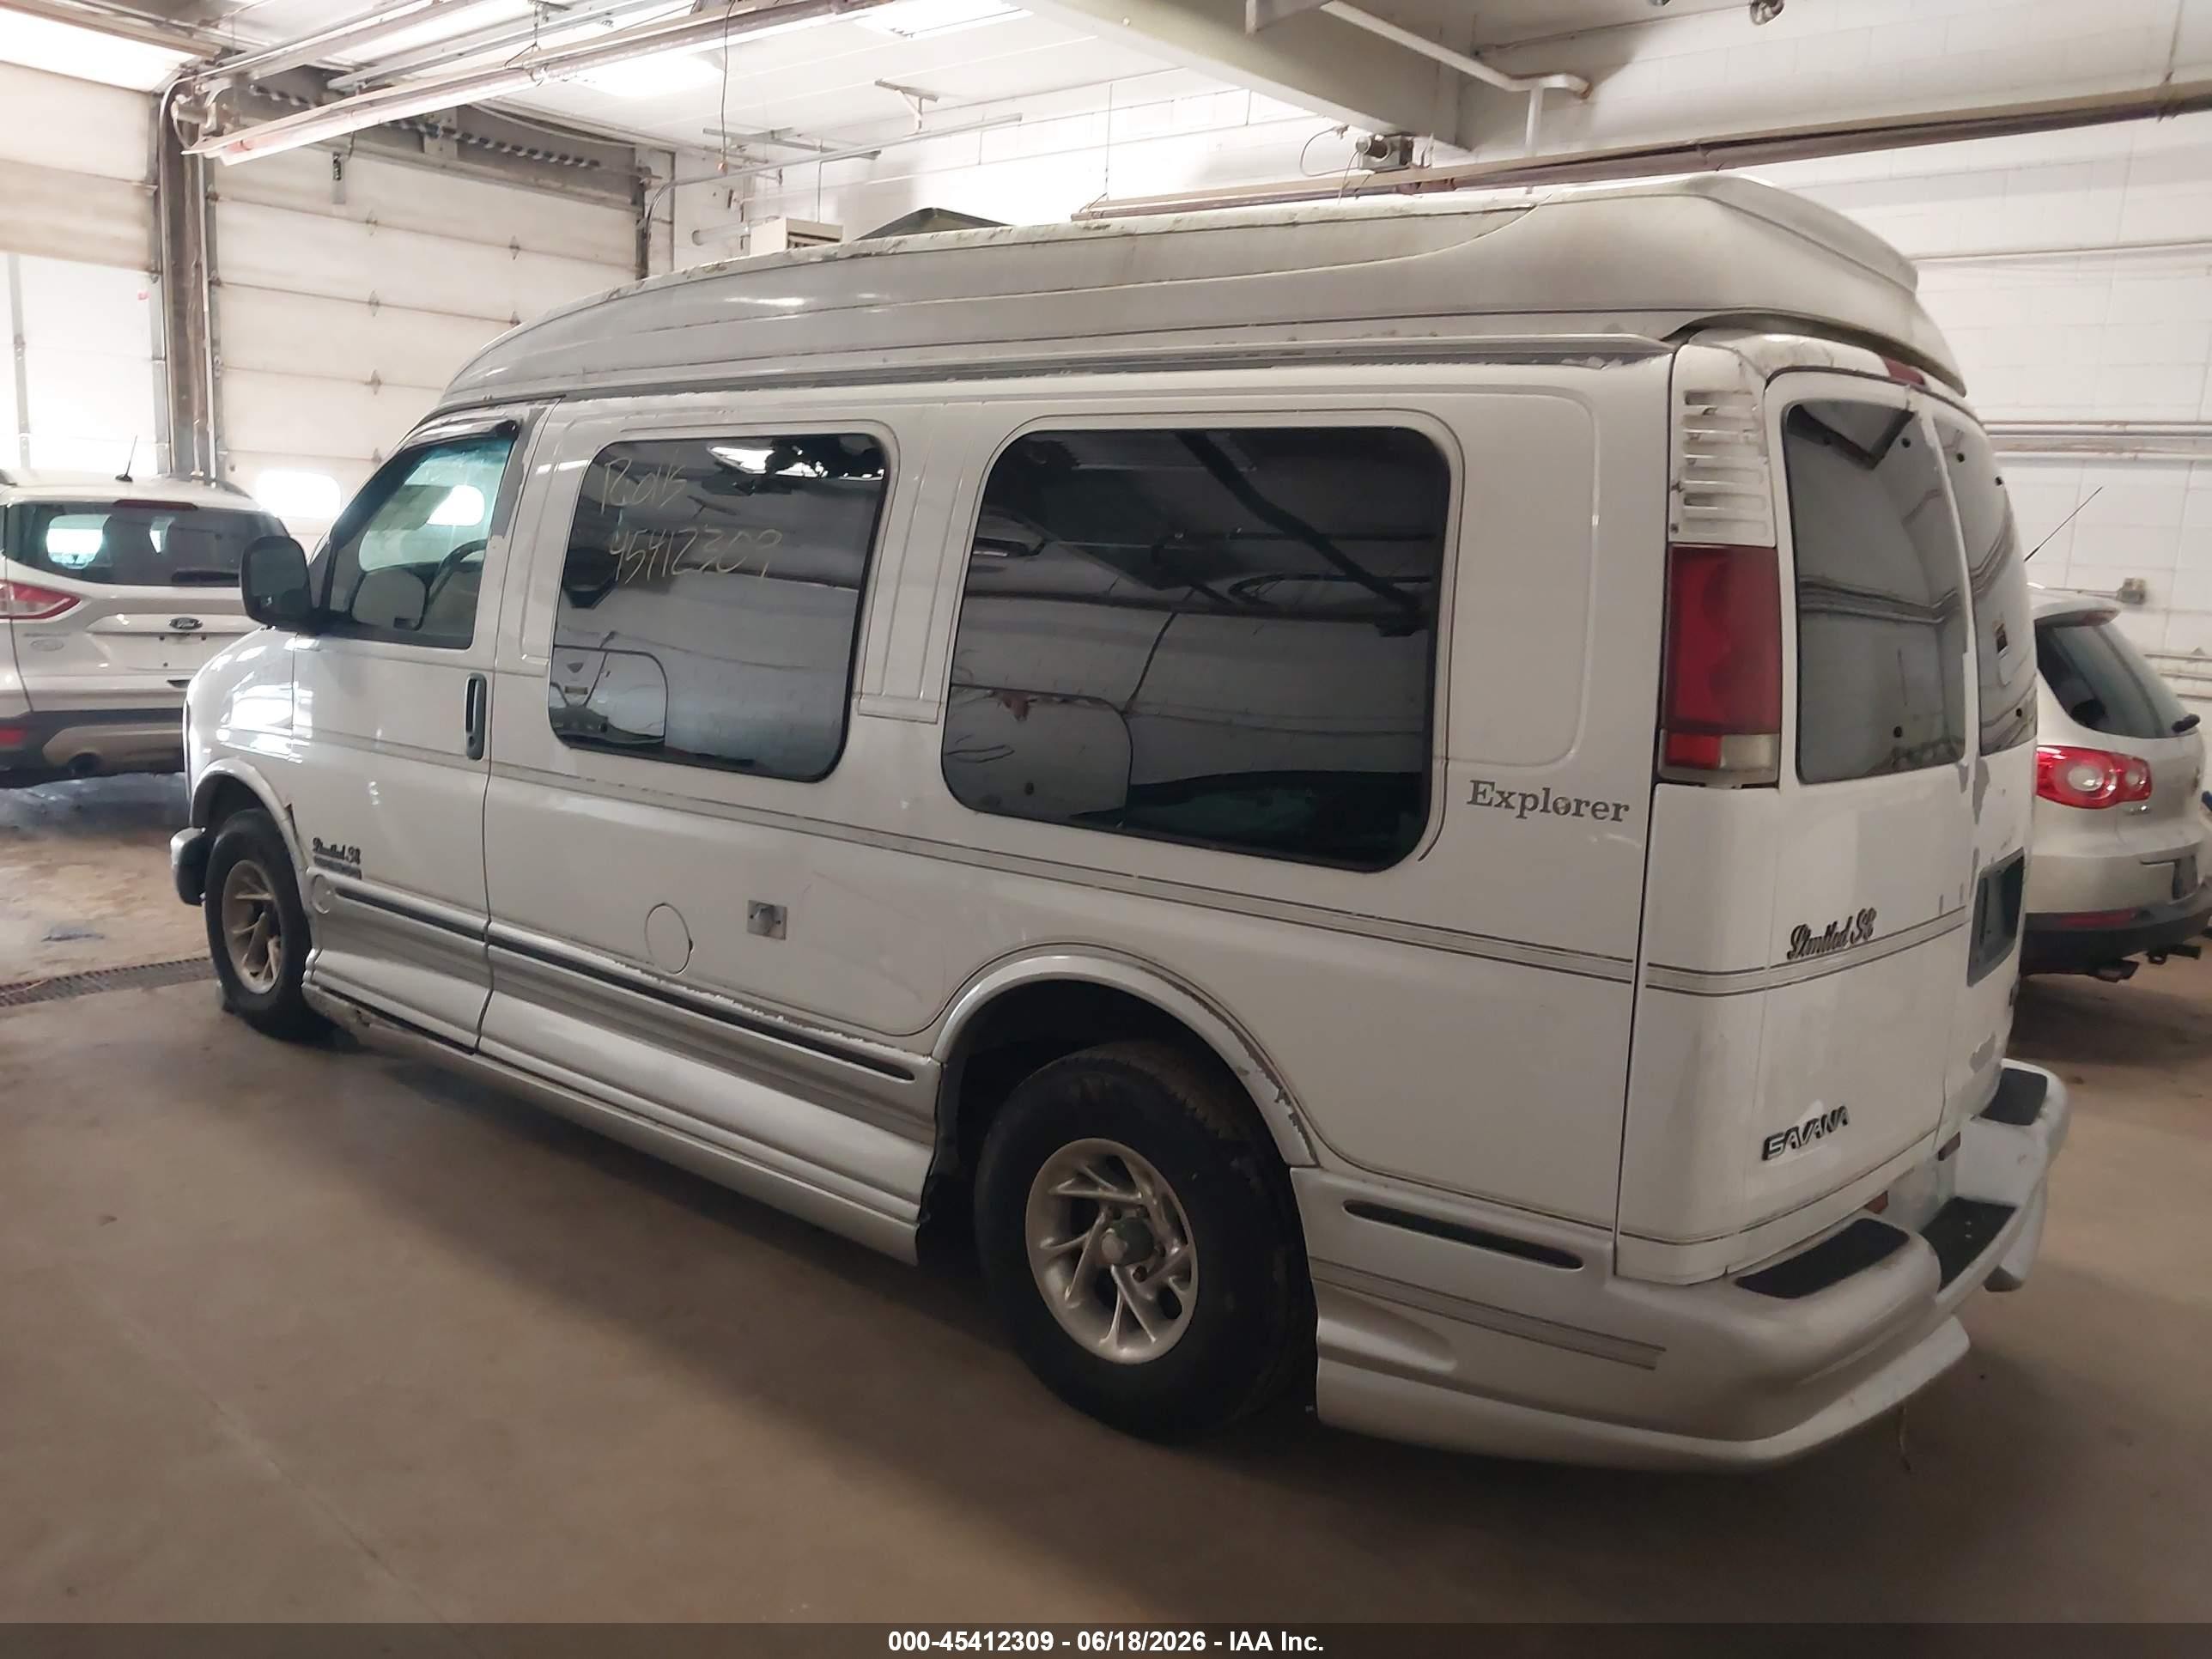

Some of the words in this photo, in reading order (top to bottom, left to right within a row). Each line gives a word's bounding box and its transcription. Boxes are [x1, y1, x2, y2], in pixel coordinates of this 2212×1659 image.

[609, 526, 783, 585] 45412309
[1466, 779, 1631, 823] Explorer
[1761, 1105, 1848, 1161] SAVANA
